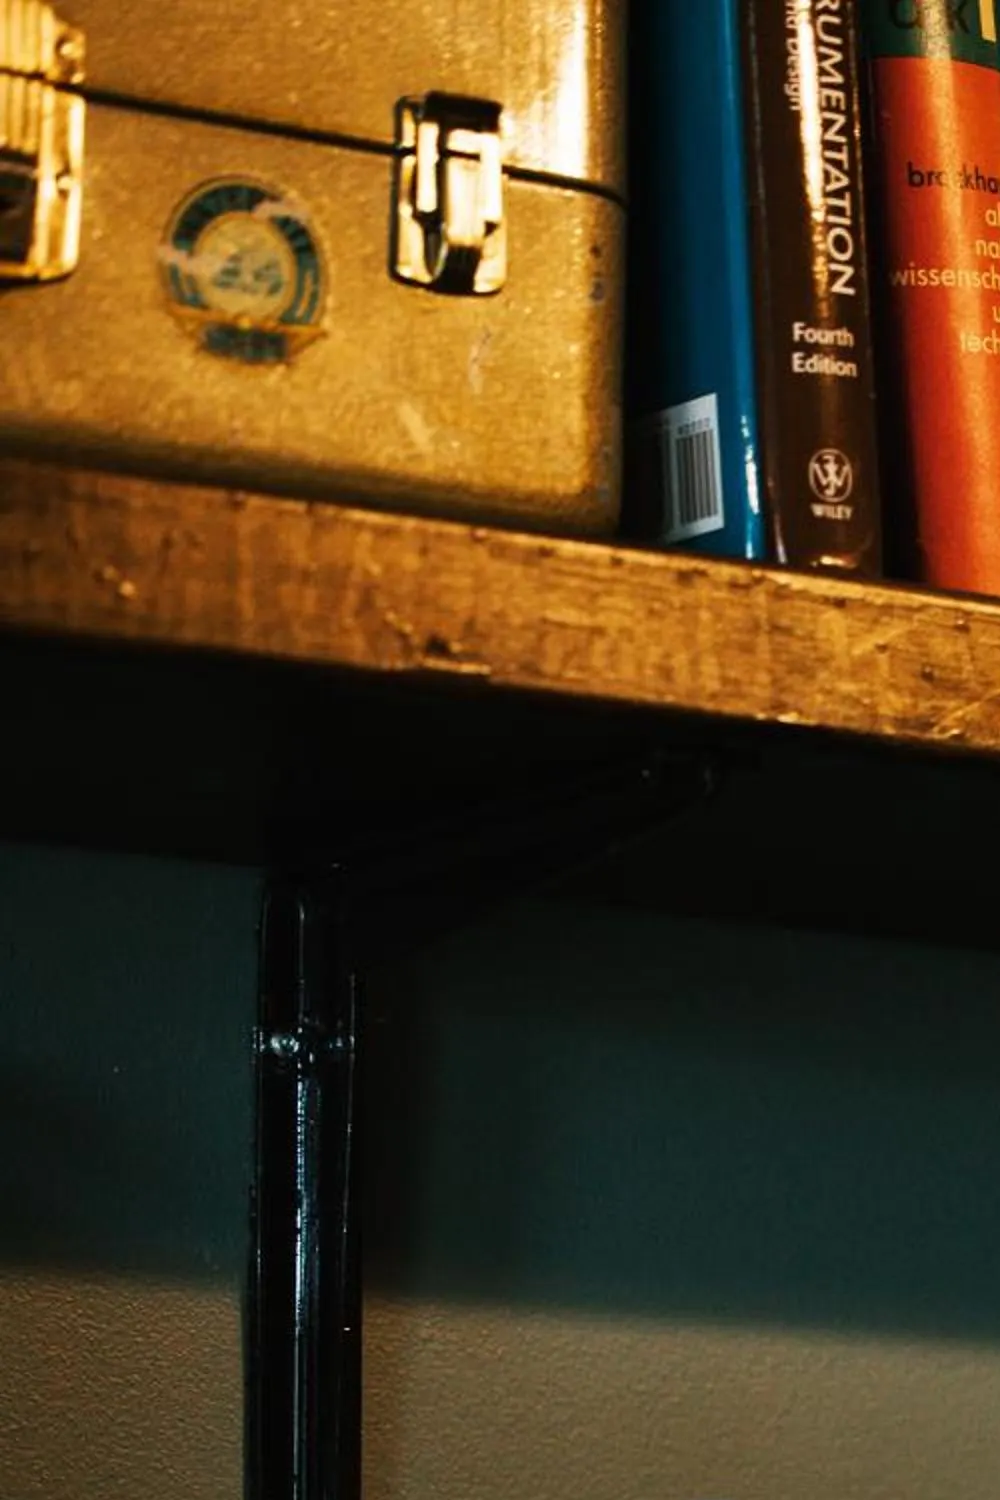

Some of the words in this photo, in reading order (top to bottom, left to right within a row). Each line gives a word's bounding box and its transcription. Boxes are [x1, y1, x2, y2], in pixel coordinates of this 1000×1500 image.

[792, 321, 855, 348] Fourth
[791, 351, 858, 378] Edition
[810, 503, 854, 521] WILEY
